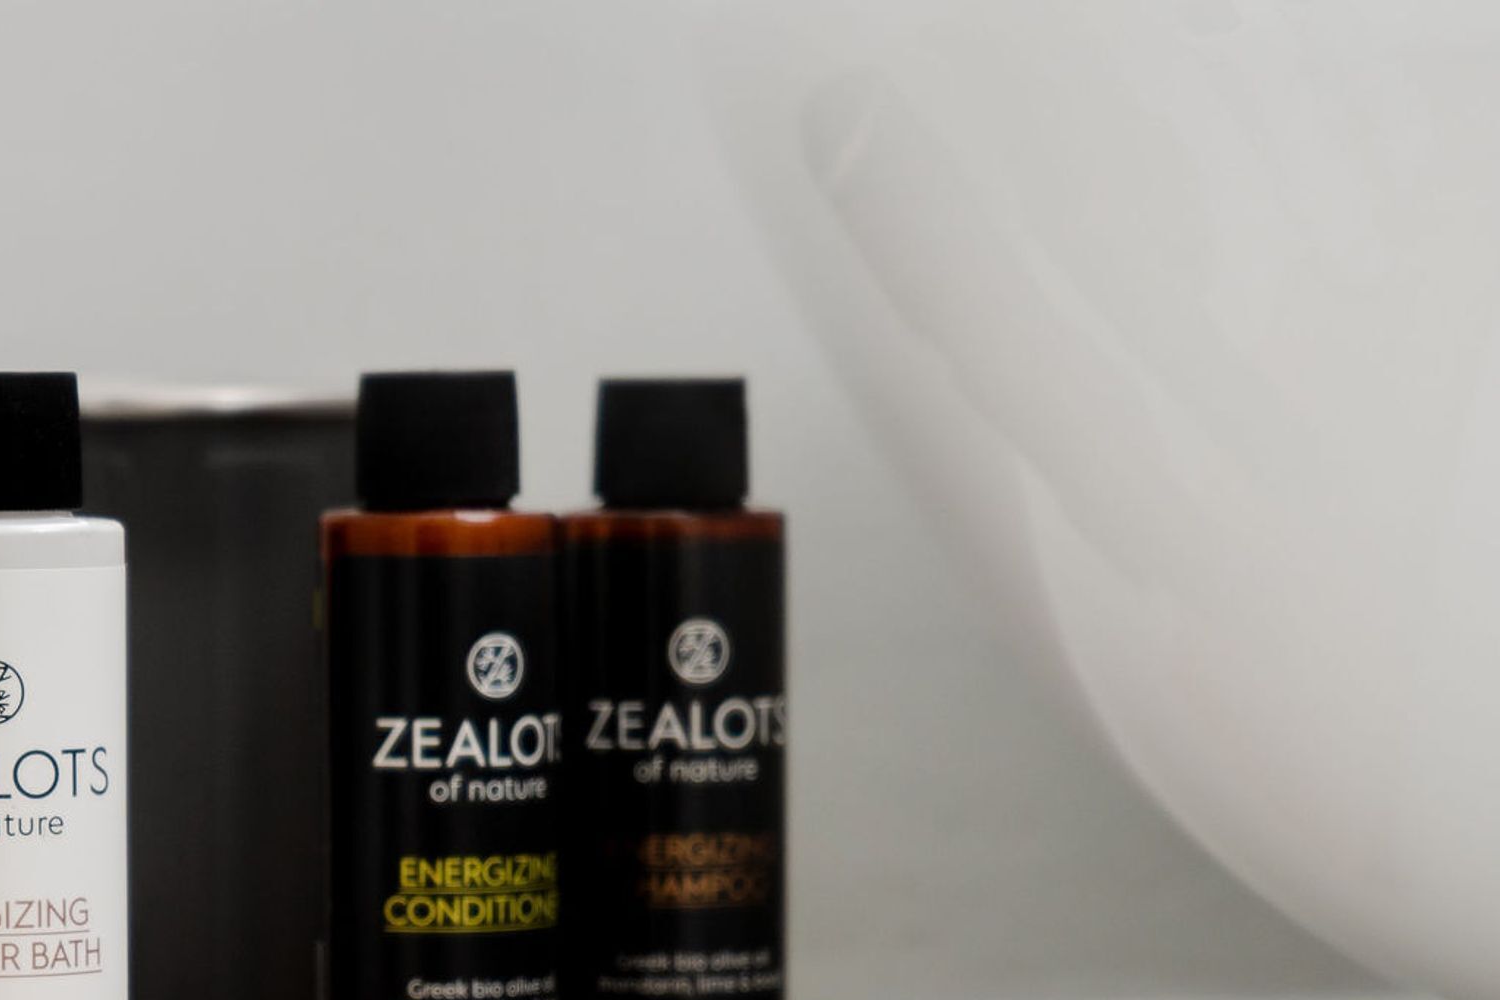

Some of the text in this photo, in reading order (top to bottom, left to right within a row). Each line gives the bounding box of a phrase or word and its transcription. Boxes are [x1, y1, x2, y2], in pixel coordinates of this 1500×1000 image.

[585, 695, 786, 751] ZEALOTS
[372, 713, 561, 768] ZEALOT
[633, 753, 759, 784] of nature
[429, 774, 547, 803] of nature
[384, 891, 558, 927] CONDITIONE
[31, 937, 101, 969] BATH
[407, 978, 469, 1000] Greek
[471, 978, 504, 999] bio
[506, 976, 541, 997] olive
